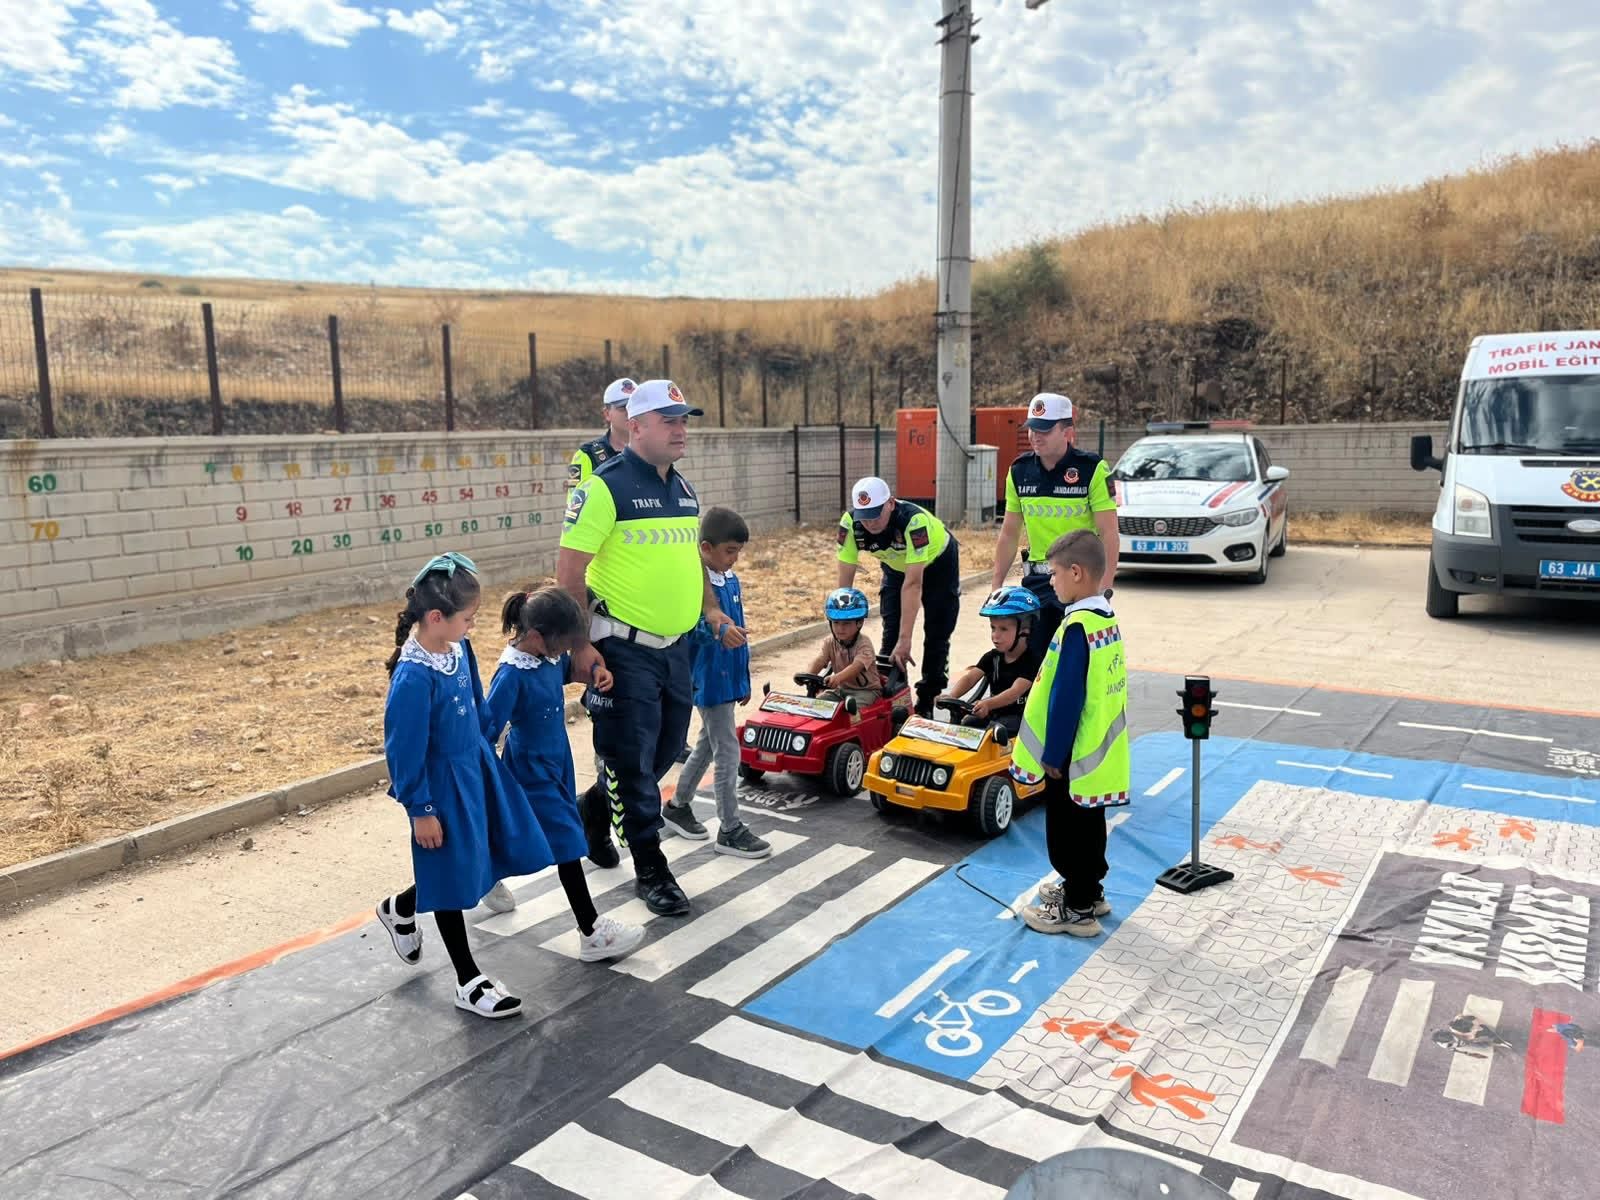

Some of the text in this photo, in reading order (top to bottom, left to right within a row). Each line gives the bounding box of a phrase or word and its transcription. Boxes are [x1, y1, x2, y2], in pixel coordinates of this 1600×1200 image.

[1488, 340, 1600, 359] TRAFİK JAN
[1488, 355, 1600, 374] MOBİL EĞİT
[28, 474, 57, 492] 60
[236, 506, 247, 521] 9
[286, 501, 302, 517] 18
[333, 497, 352, 512] 27
[379, 494, 396, 508] 36
[422, 491, 438, 503] 45
[459, 488, 474, 500] 54
[496, 485, 510, 497] 63
[531, 482, 543, 494] 72
[31, 521, 60, 540] 70
[235, 513, 542, 560] 10 20 30 40 50 60 70 80
[1136, 543, 1148, 551] 63
[1152, 542, 1169, 551] JAA
[1548, 562, 1596, 576] 63 JAA
